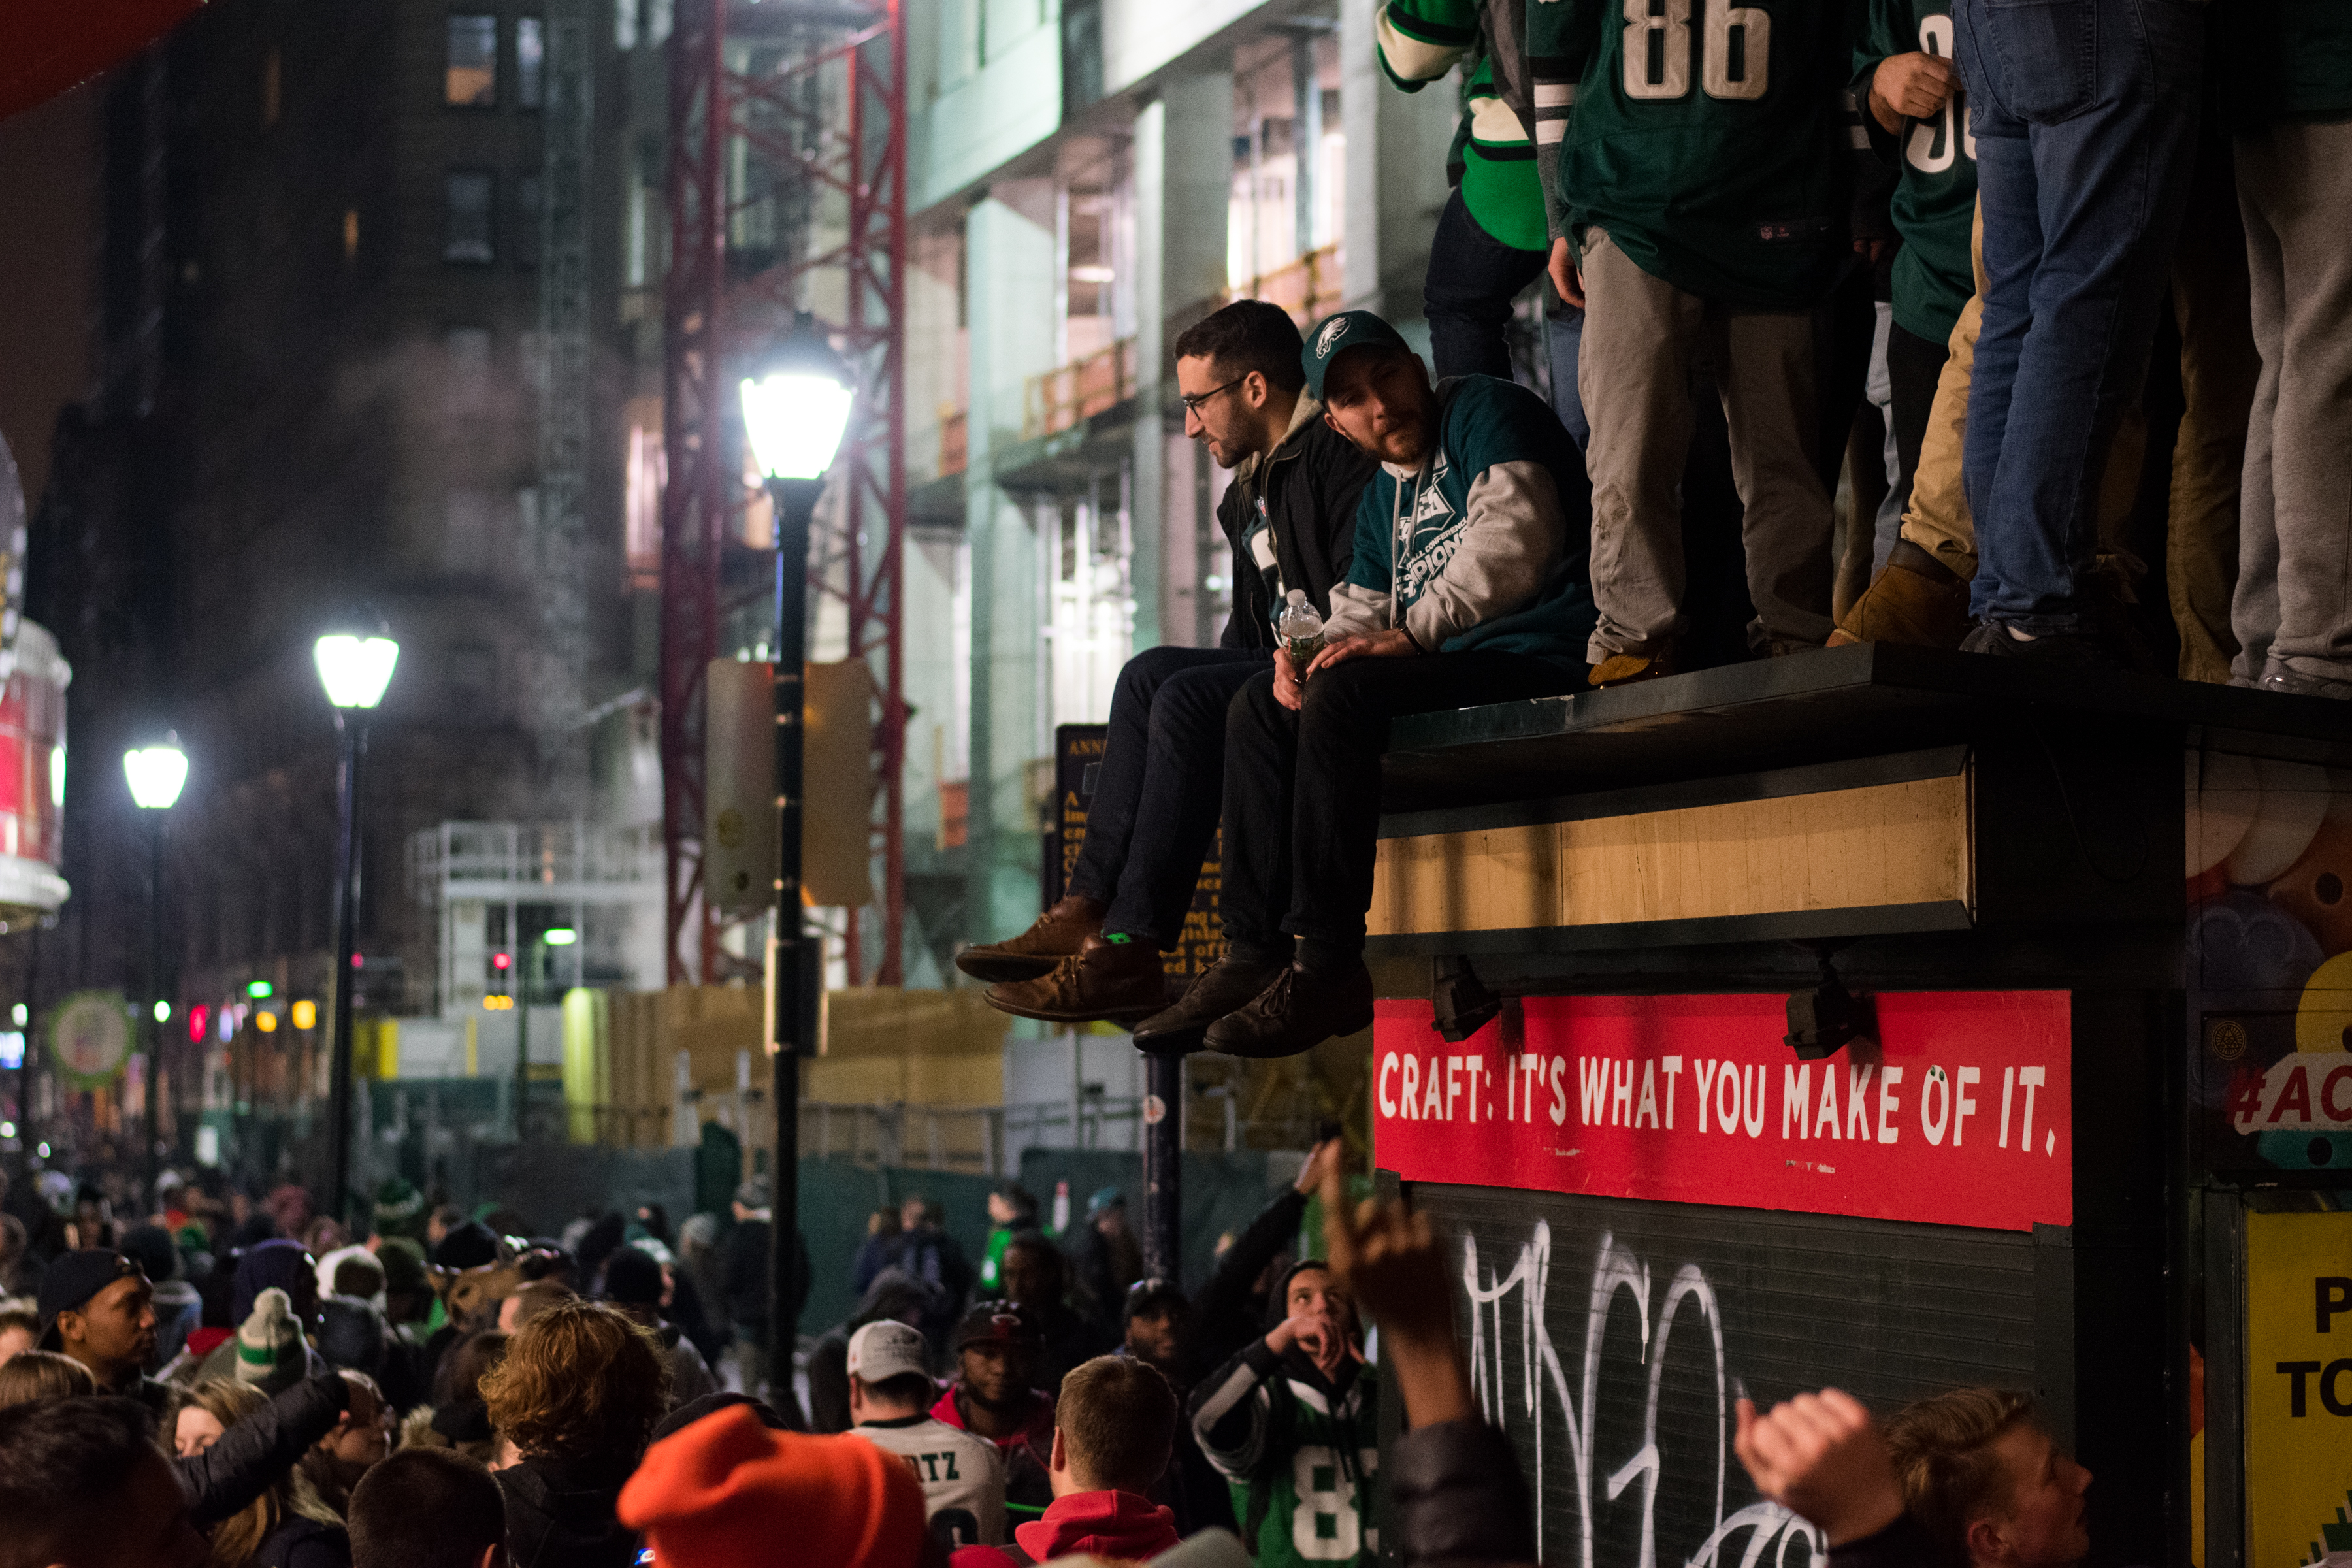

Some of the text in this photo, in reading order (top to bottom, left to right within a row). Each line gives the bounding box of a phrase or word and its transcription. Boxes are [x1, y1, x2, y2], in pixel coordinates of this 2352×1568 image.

[1623, 0, 1771, 100] 86
[1379, 1051, 2056, 1158] CRAFT: IT'S WHAT YOU MAKE OF IT.
